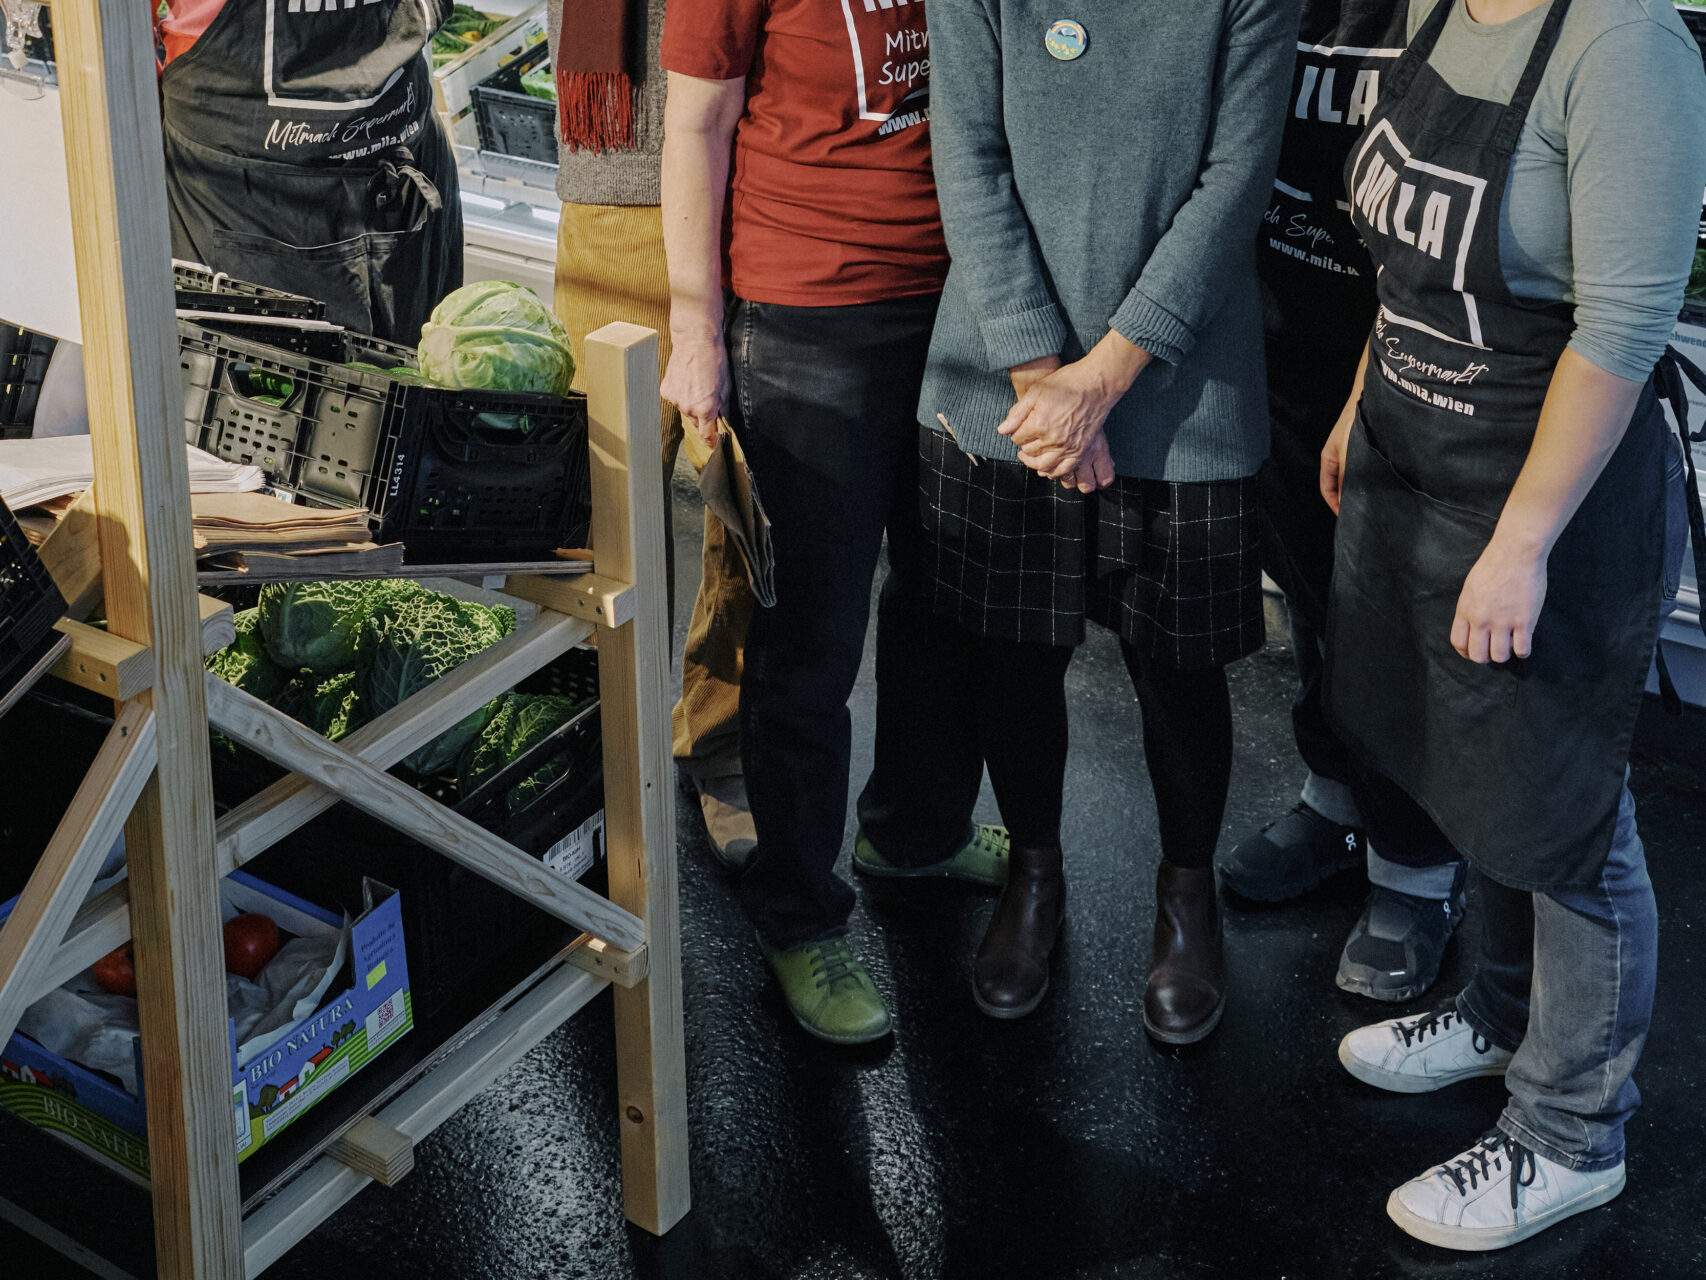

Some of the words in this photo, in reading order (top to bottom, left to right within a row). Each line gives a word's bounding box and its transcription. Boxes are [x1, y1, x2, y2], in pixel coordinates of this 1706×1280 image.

[878, 58, 931, 89] Supe
[1295, 64, 1380, 127] ILA
[328, 120, 420, 160] ww.mila.wien
[1385, 337, 1490, 386] Supermarkt
[389, 454, 406, 497] LL4314
[250, 1050, 282, 1083] BIO
[286, 999, 353, 1056] NATURA
[43, 1095, 78, 1129] BIO
